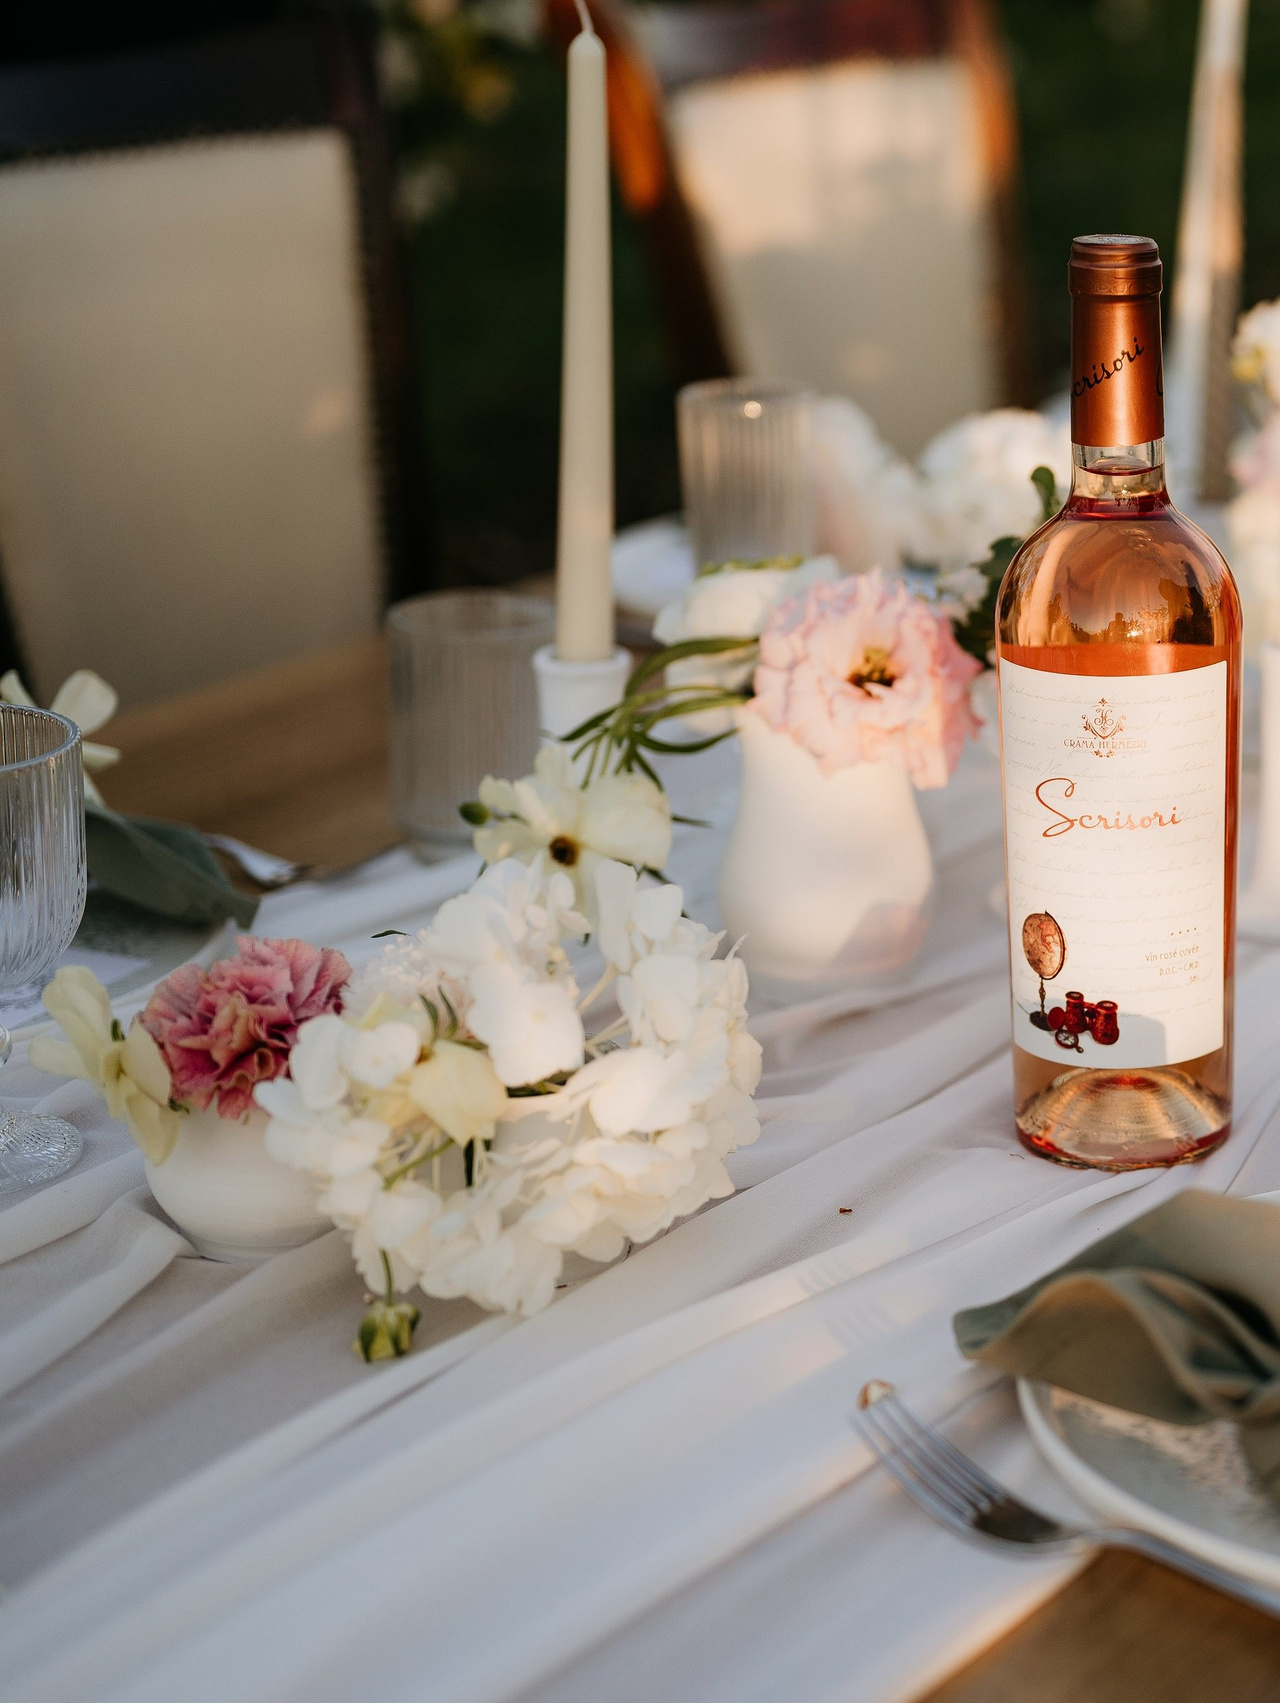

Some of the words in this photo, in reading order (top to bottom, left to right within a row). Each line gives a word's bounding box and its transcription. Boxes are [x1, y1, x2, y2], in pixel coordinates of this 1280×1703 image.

[1071, 336, 1145, 397] crisori
[1035, 777, 1182, 838] Scrisori
[1145, 952, 1158, 961] vin
[1160, 948, 1178, 960] rosé
[1179, 944, 1200, 957] cuvée
